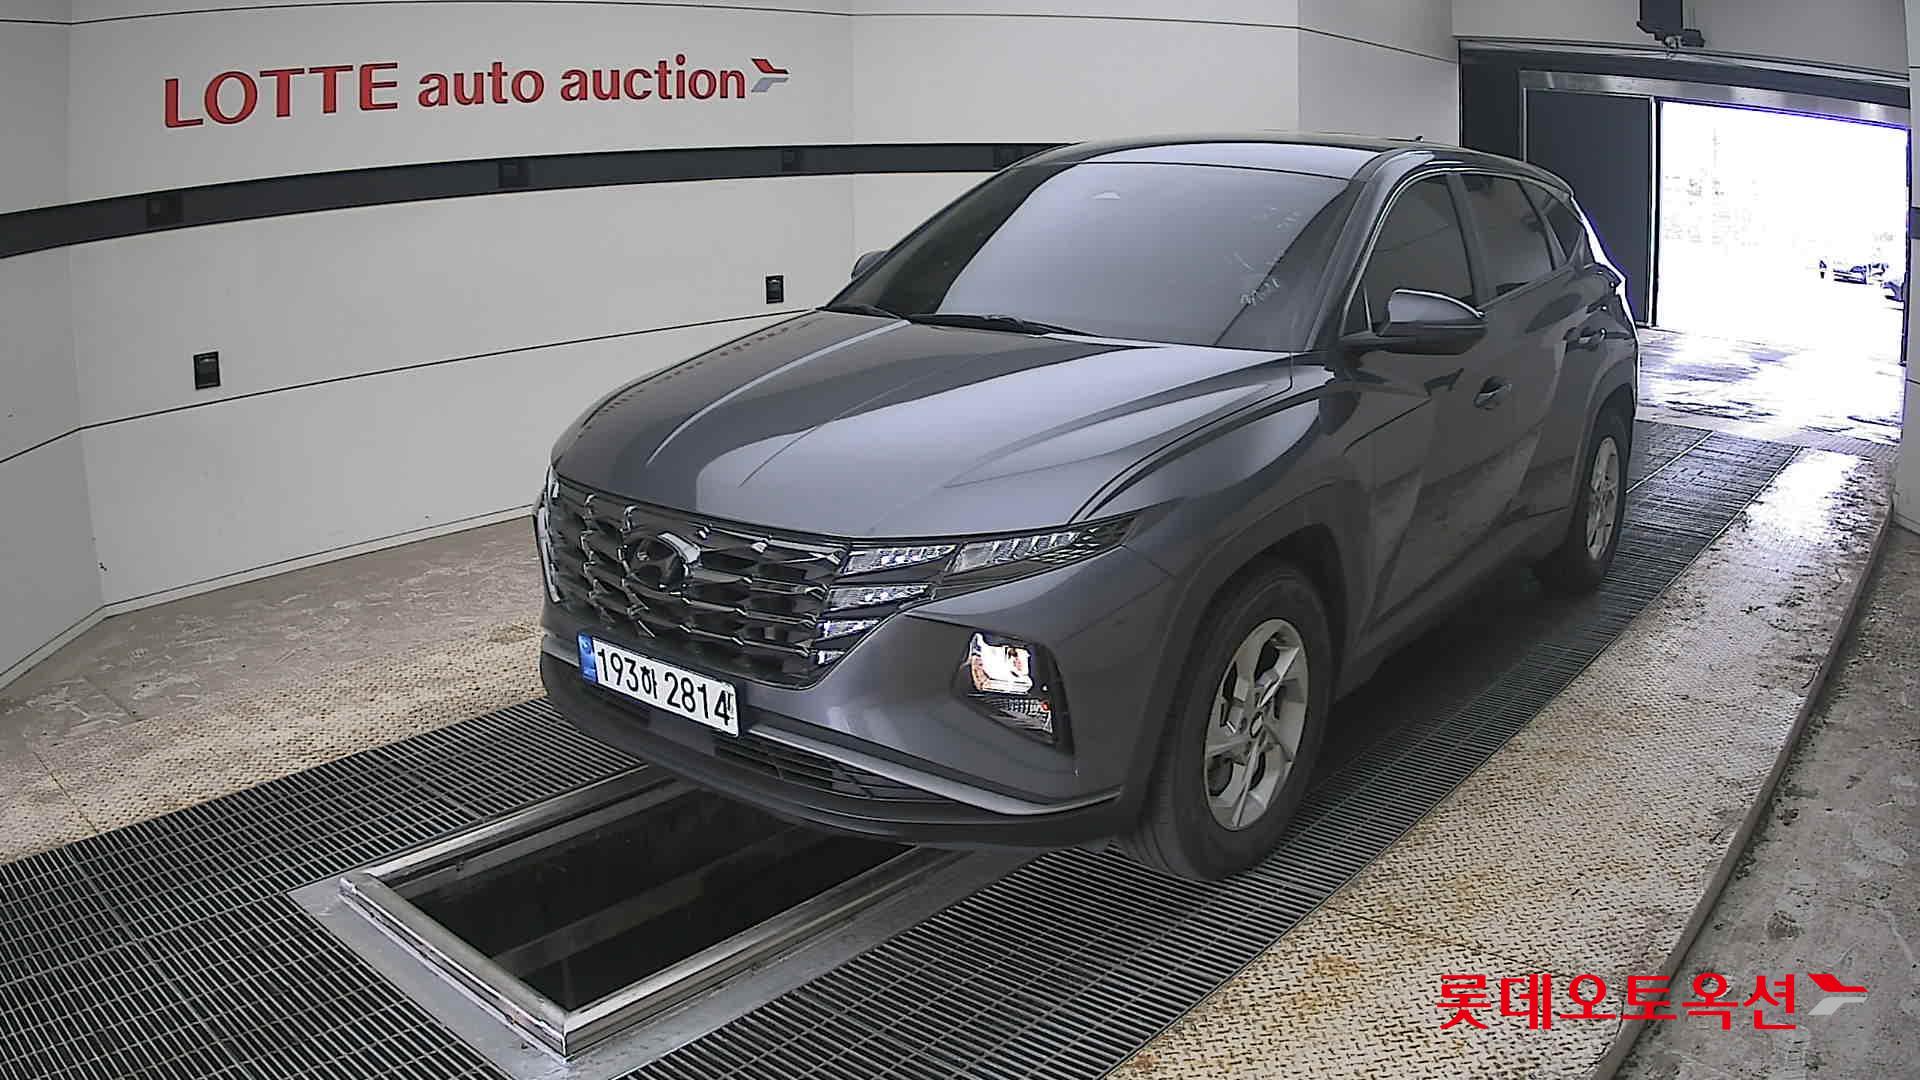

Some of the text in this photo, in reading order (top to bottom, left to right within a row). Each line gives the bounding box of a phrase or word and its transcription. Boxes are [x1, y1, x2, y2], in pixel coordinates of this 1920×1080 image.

[164, 54, 747, 129] LOTTE auto auction
[597, 648, 732, 726] 193하 2814
